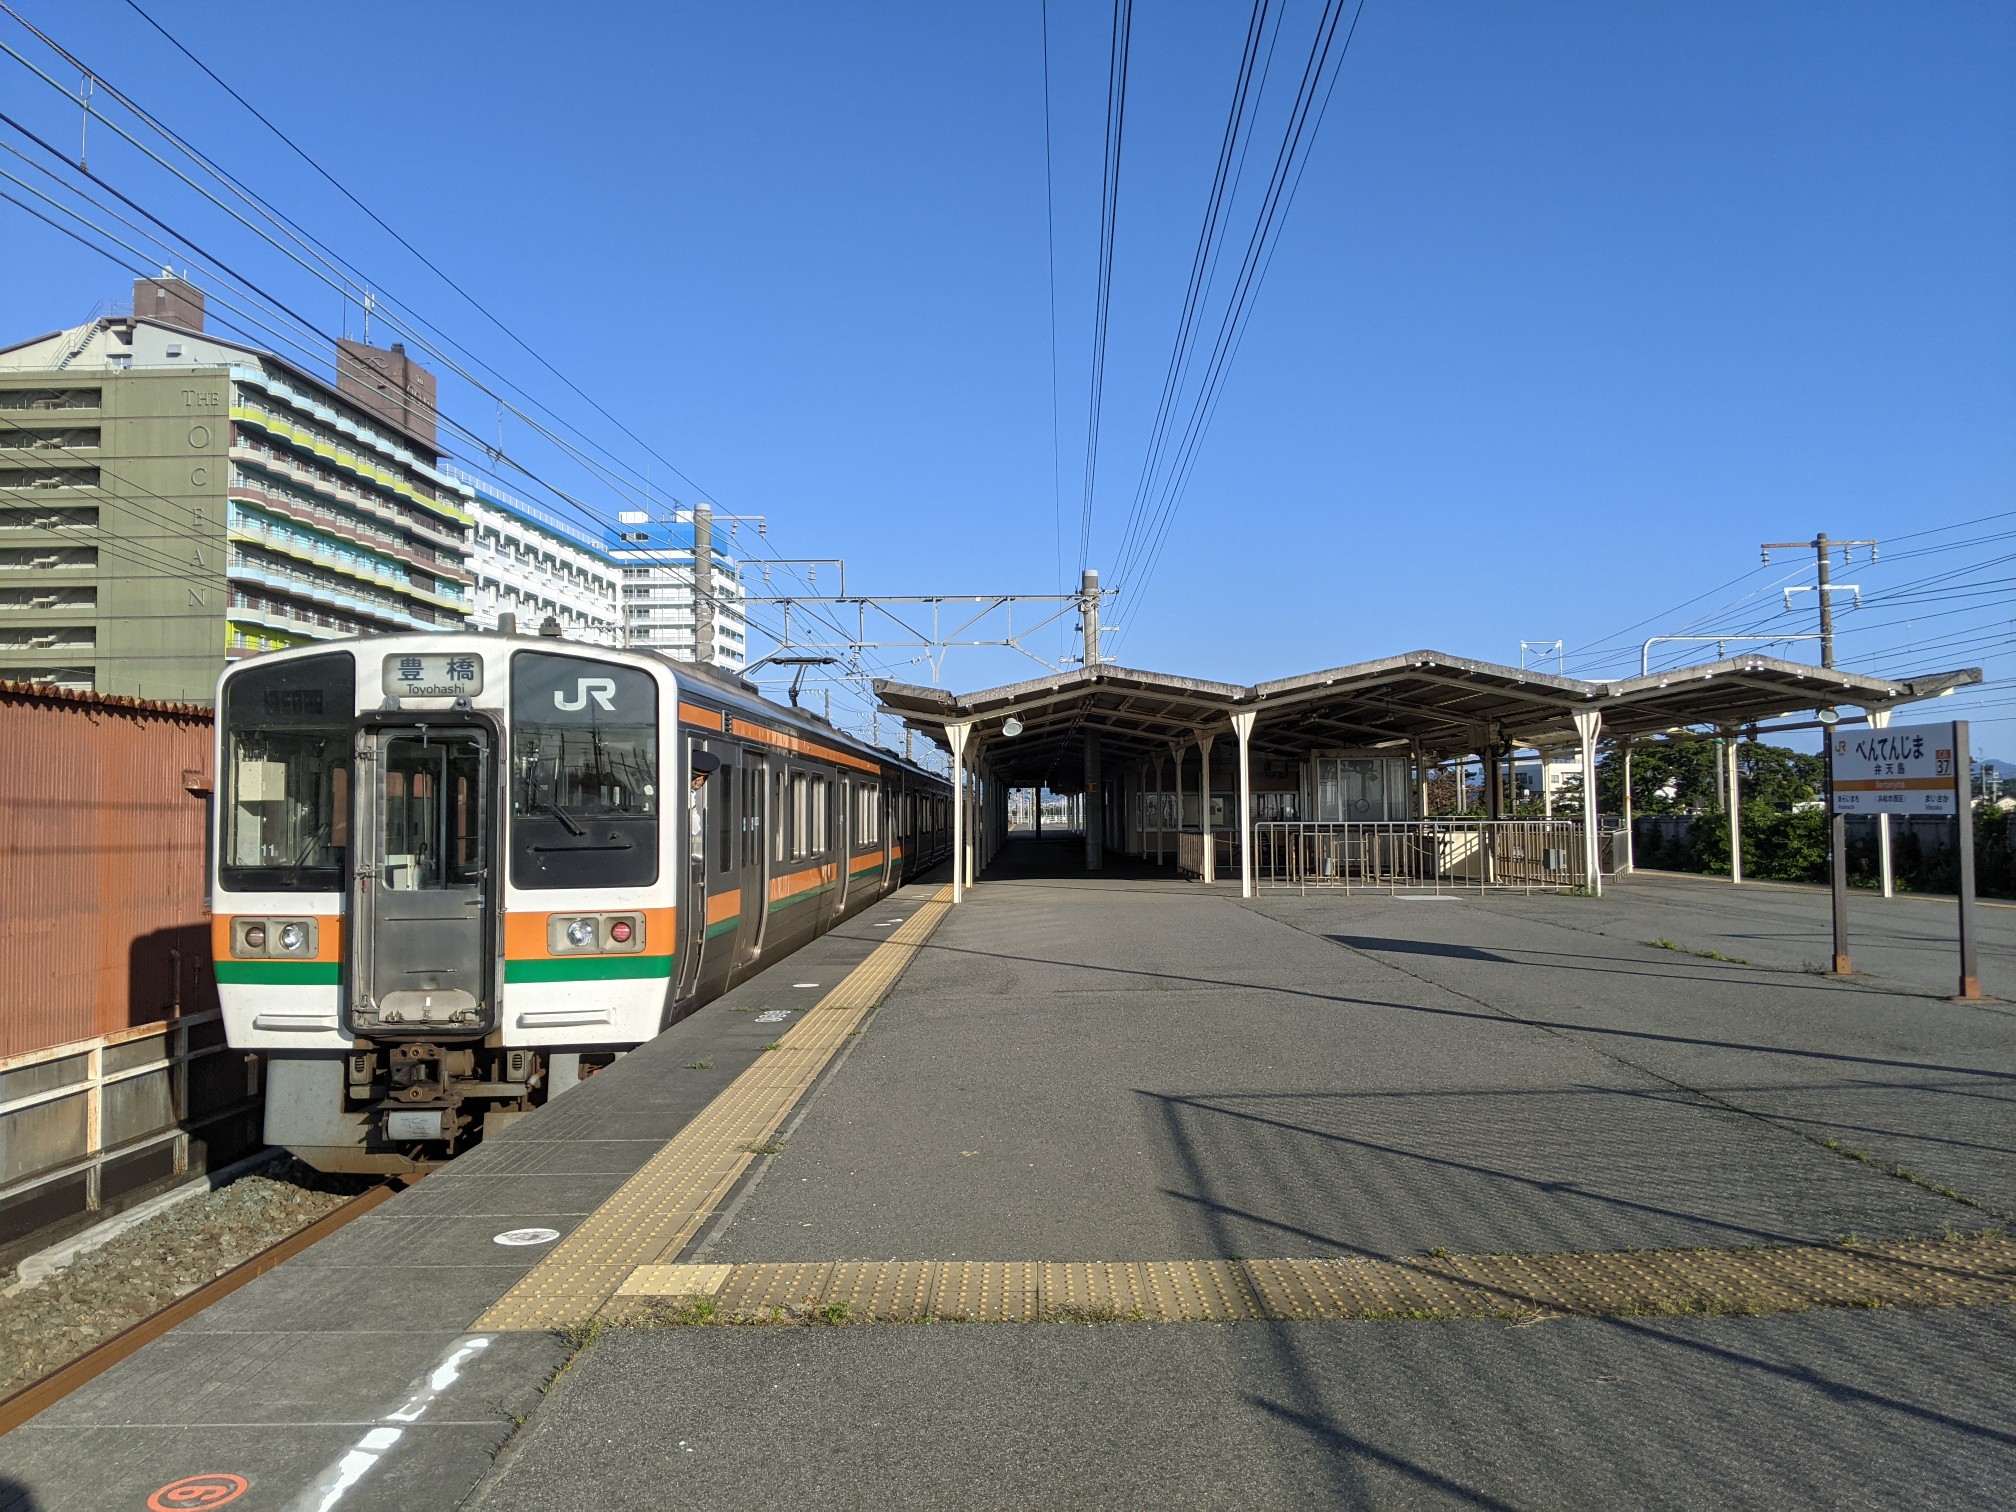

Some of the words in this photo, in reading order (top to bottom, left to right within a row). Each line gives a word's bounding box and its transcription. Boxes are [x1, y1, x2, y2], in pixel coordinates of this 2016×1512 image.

[181, 389, 219, 407] THE
[187, 425, 211, 607] OCEAN
[397, 657, 475, 682] 豊橋
[406, 683, 465, 696] Toyohashi
[553, 677, 616, 711] JR
[1834, 740, 1846, 752] JR
[1855, 735, 1924, 762] べんてんじま
[1873, 763, 1905, 775] 弁天島
[1937, 760, 1950, 775] 37
